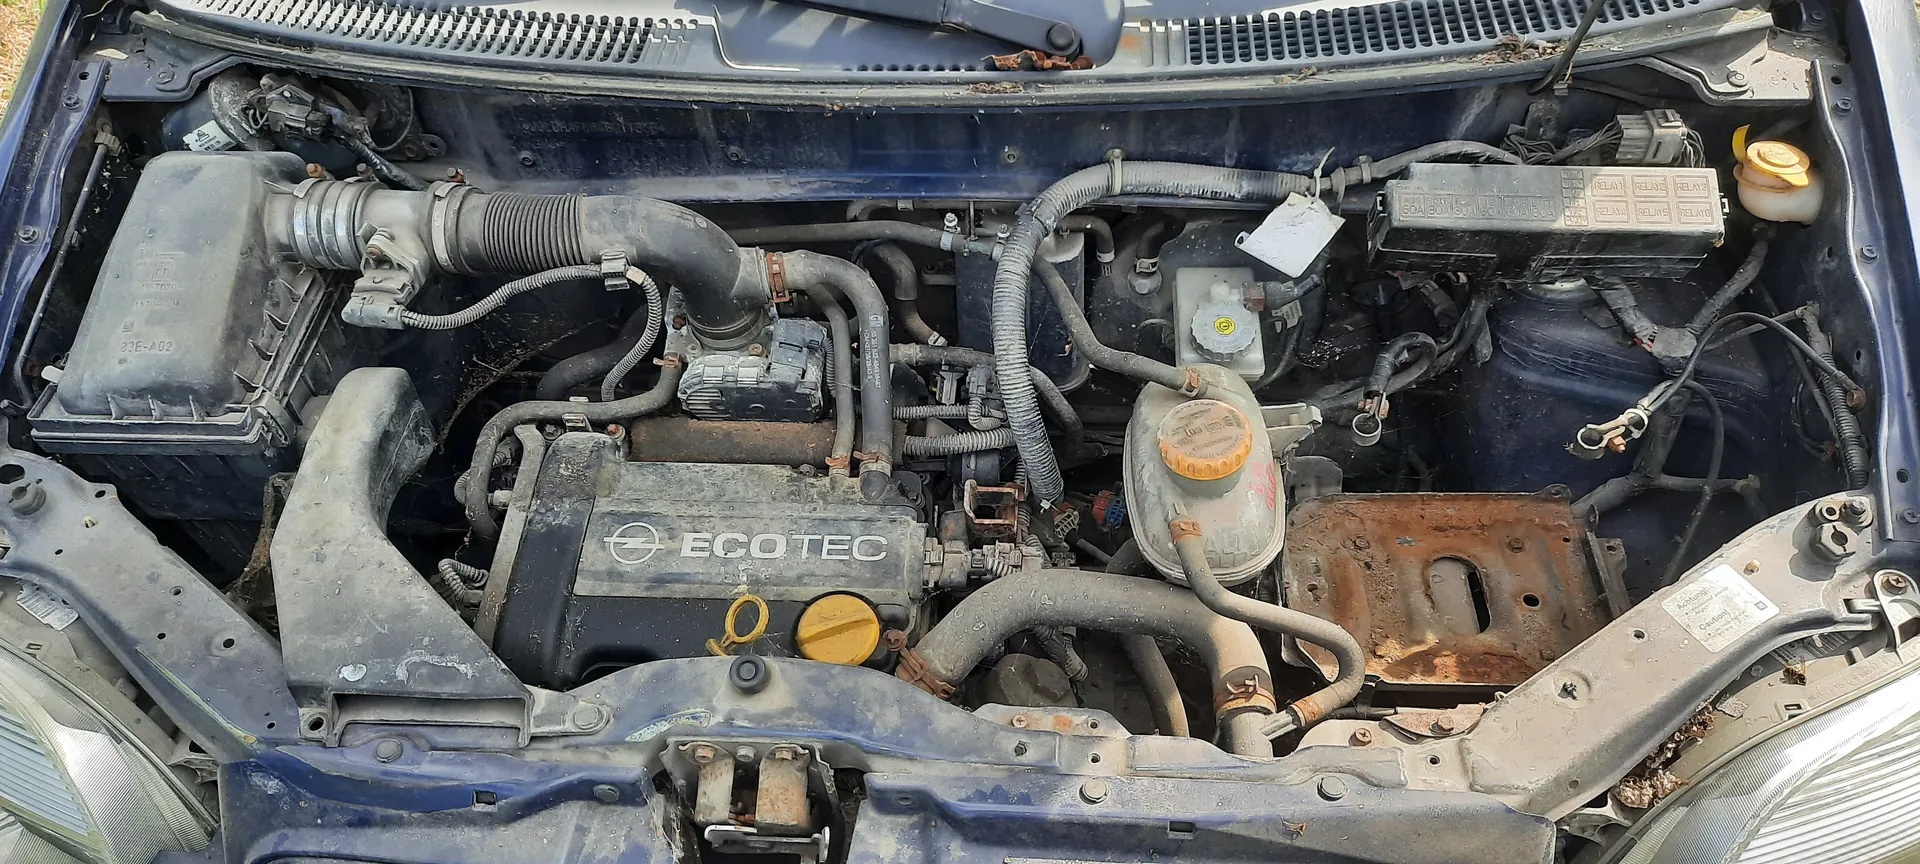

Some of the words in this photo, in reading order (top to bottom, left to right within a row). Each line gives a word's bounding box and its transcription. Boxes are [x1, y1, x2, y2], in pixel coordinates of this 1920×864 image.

[680, 531, 889, 561] ECOTEC
[1676, 586, 1710, 611] Achtung!
[1698, 608, 1730, 631] Caution!
